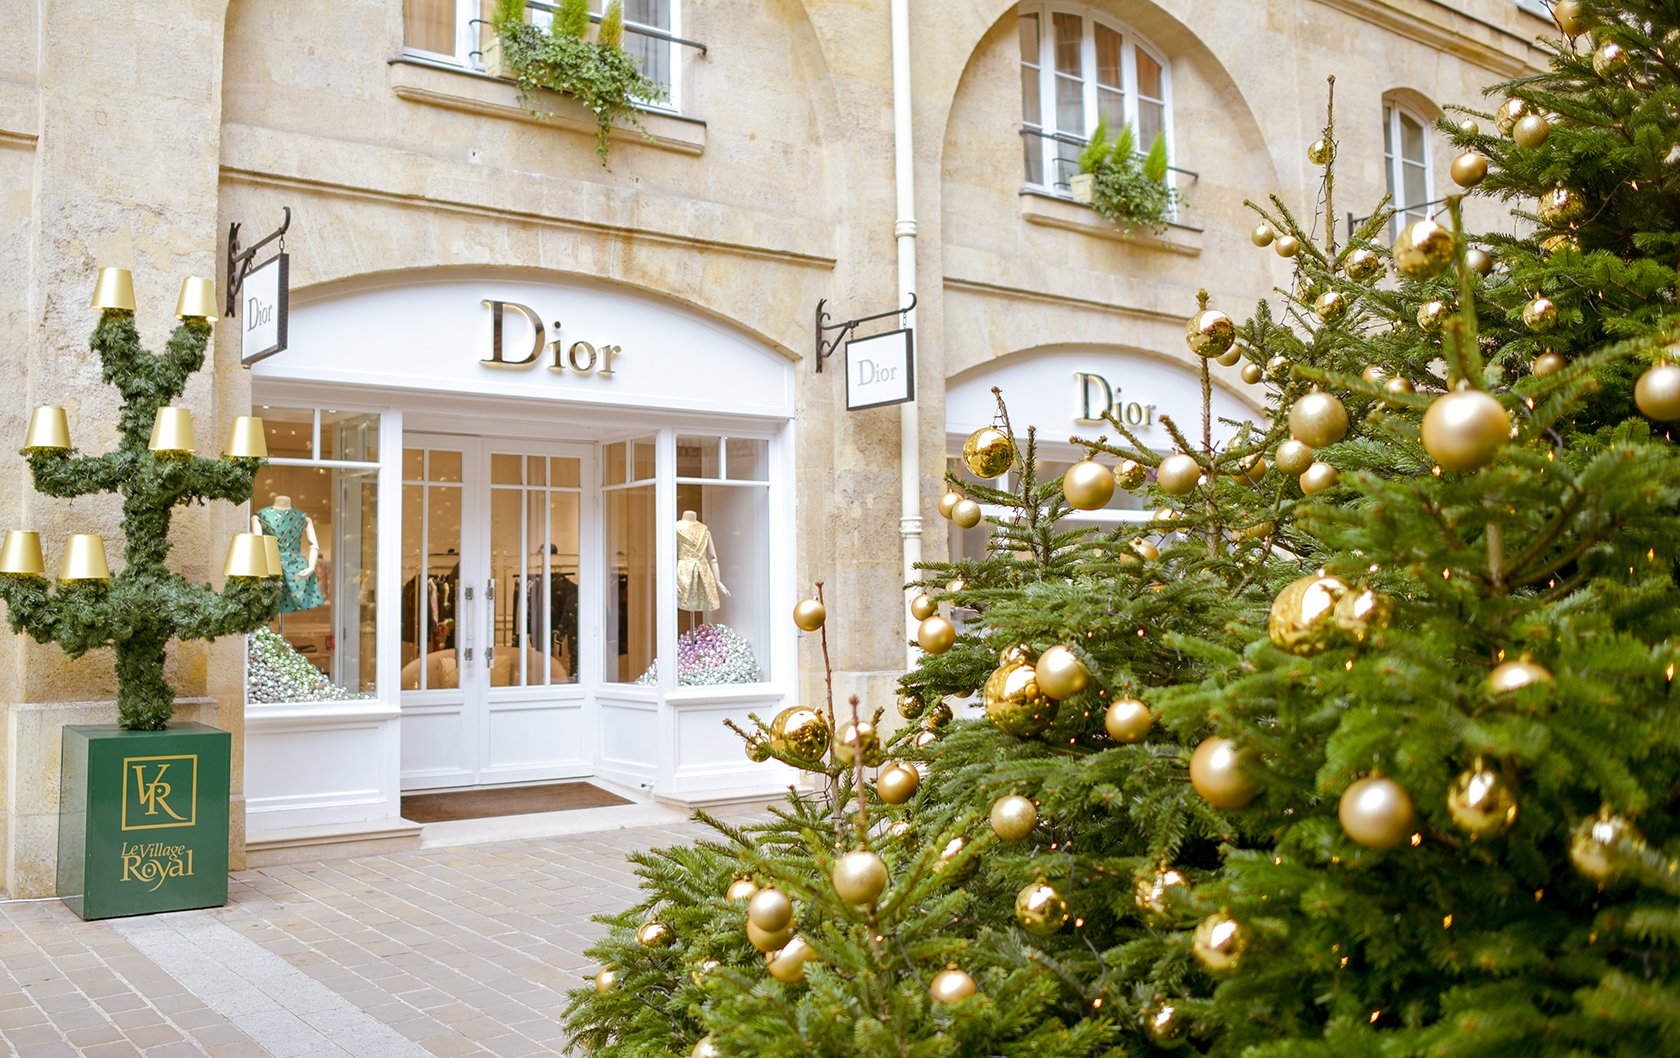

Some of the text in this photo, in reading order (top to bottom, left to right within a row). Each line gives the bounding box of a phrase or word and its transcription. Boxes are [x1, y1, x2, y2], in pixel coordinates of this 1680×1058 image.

[248, 297, 272, 331] Dior
[479, 299, 622, 375] Dior
[857, 359, 897, 386] Dior
[1073, 372, 1157, 427] Dior
[121, 842, 186, 860] Le Village
[120, 849, 194, 892] Royal
